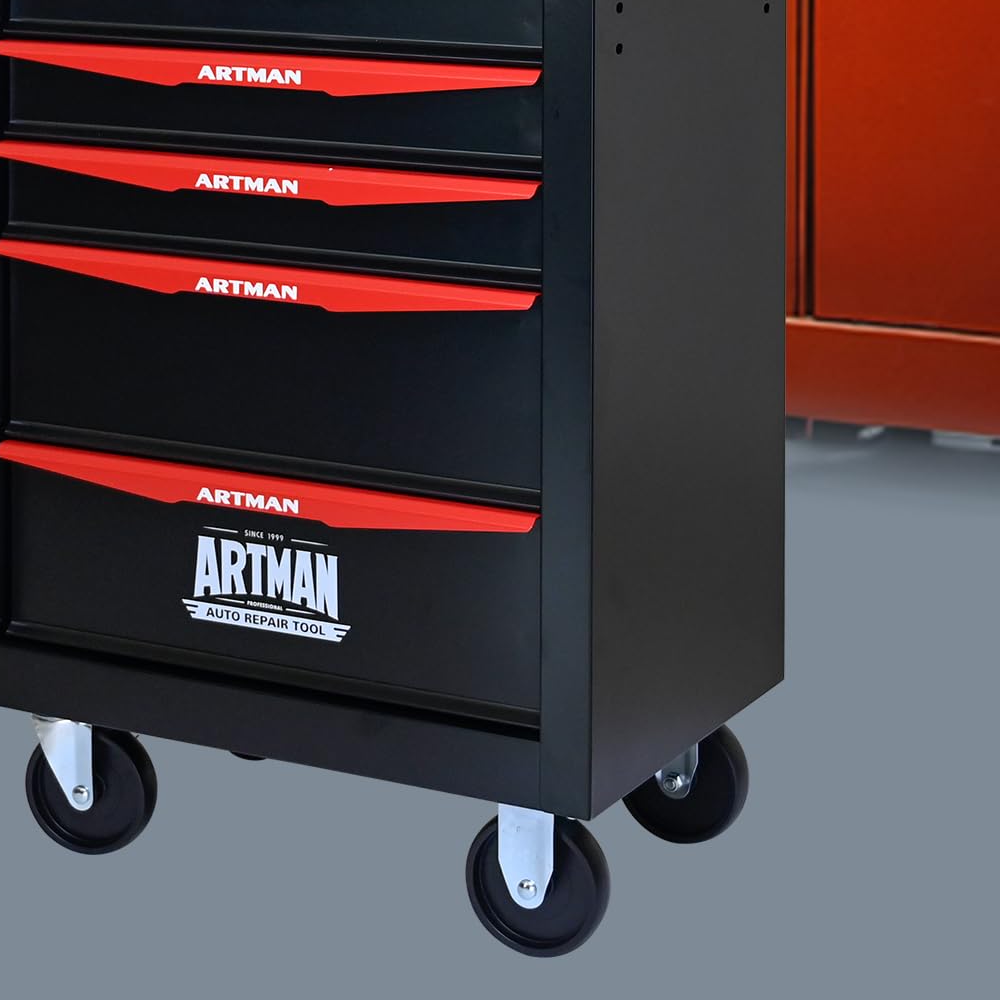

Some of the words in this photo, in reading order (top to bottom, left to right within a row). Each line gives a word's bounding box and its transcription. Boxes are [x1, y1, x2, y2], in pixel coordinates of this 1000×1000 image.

[198, 65, 301, 85] ARTMAN
[195, 173, 298, 195] ARTMAN
[195, 277, 297, 301] ARTMAN
[196, 487, 299, 514] ARTMAN
[244, 529, 264, 539] SINCE
[267, 532, 284, 542] 1999
[193, 535, 340, 621] ARTMAN
[246, 600, 283, 611] PROFESSIONAL
[206, 607, 241, 622] AUTO
[244, 611, 289, 630] REPAIR
[292, 620, 326, 636] TOOL
